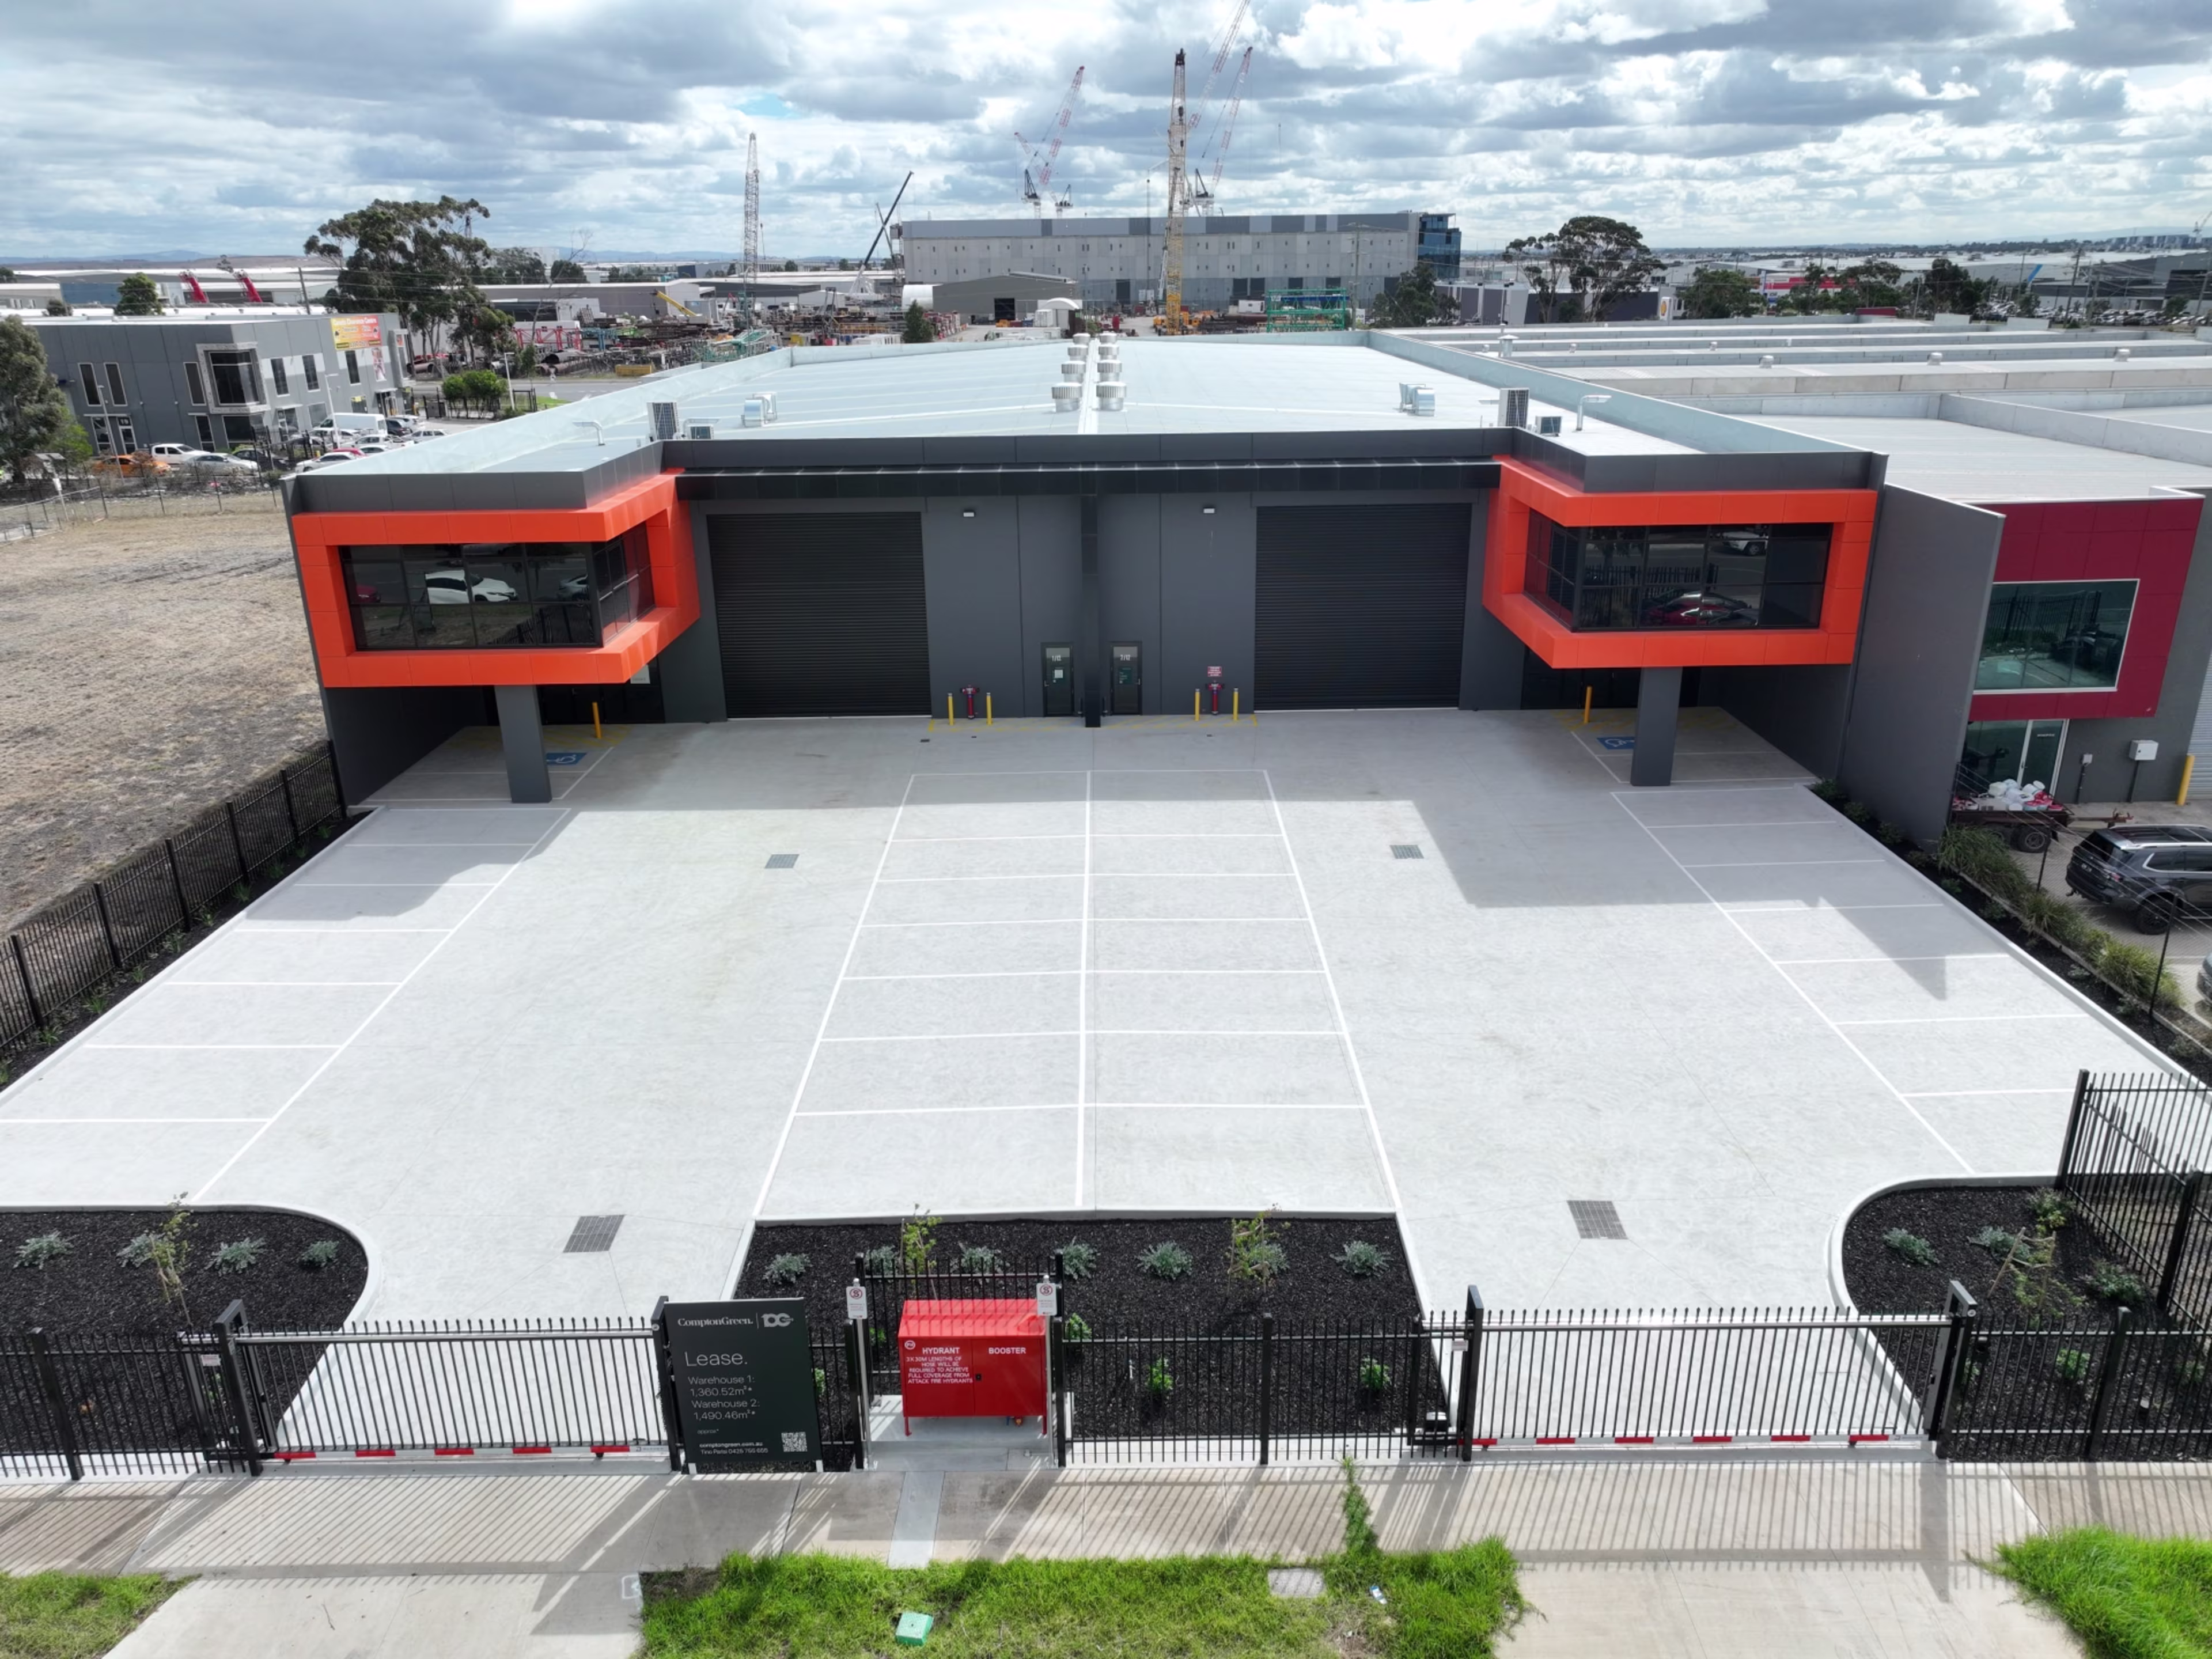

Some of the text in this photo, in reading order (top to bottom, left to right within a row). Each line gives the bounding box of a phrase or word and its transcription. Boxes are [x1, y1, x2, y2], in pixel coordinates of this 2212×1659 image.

[677, 1316, 753, 1327] ComptonGreen.
[684, 1351, 748, 1366] Lease.
[688, 1376, 744, 1385] Warehouse
[691, 1399, 760, 1408] Warehouse 2:
